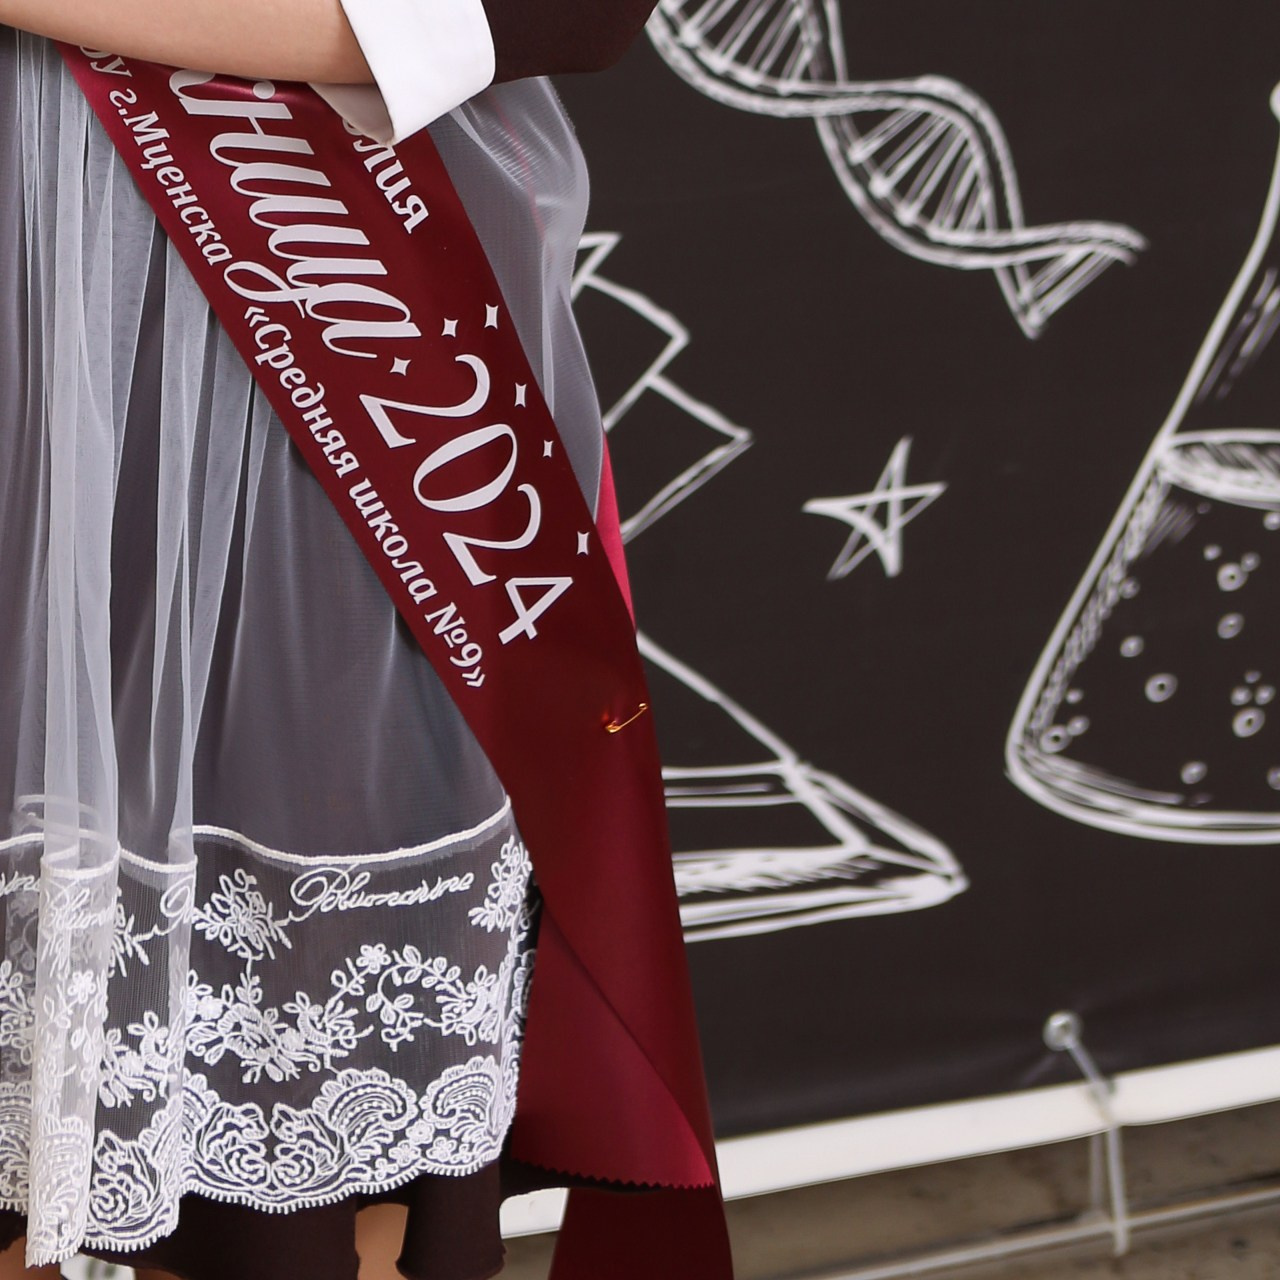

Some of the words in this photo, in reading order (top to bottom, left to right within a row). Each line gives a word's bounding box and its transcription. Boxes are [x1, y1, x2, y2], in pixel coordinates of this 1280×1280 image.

[108, 86, 234, 267] г.Мценска
[242, 305, 360, 480] «Средняя
[348, 477, 438, 606] школа
[425, 602, 488, 689] №9»
[358, 352, 575, 646] 2024
